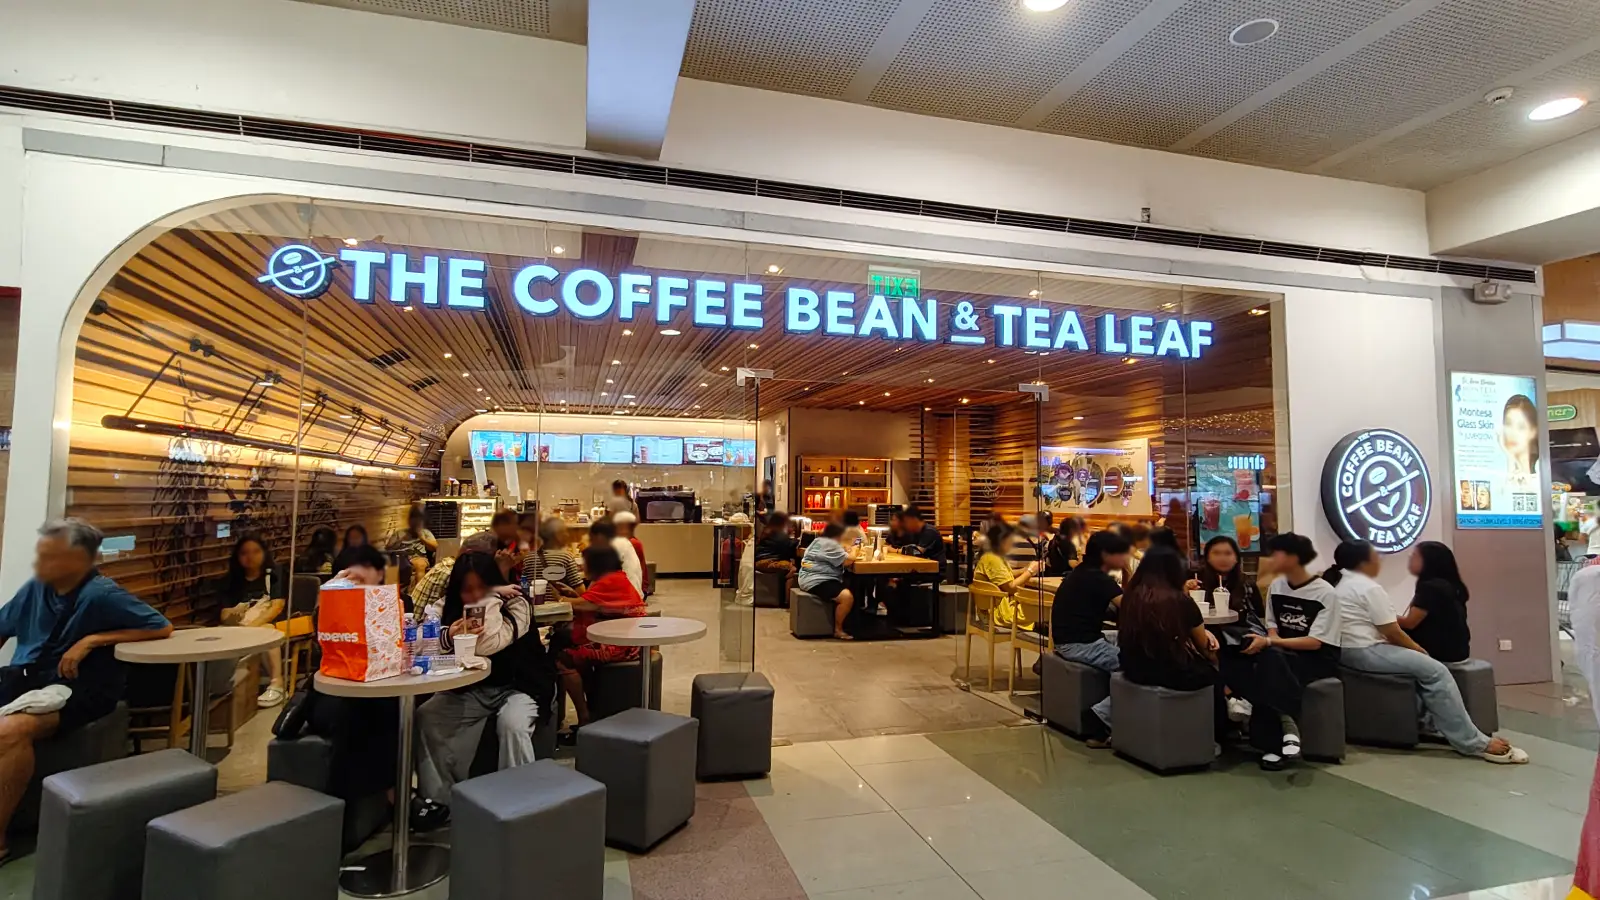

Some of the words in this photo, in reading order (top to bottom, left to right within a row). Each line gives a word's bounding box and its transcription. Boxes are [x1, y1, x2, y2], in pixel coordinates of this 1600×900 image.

[340, 249, 485, 308] THE
[514, 264, 764, 329] COFFEE
[787, 287, 937, 340] BEAN
[954, 301, 981, 334] &
[993, 304, 1089, 350] TEA
[1105, 314, 1213, 359] LEAF
[1457, 419, 1477, 429] Glass
[1478, 419, 1495, 430] Skin
[1459, 407, 1493, 418] Montesa
[1342, 441, 1375, 497] COFFEE
[1375, 439, 1413, 468] BEAN
[1368, 526, 1396, 544] TEA
[1396, 503, 1423, 539] LEAF
